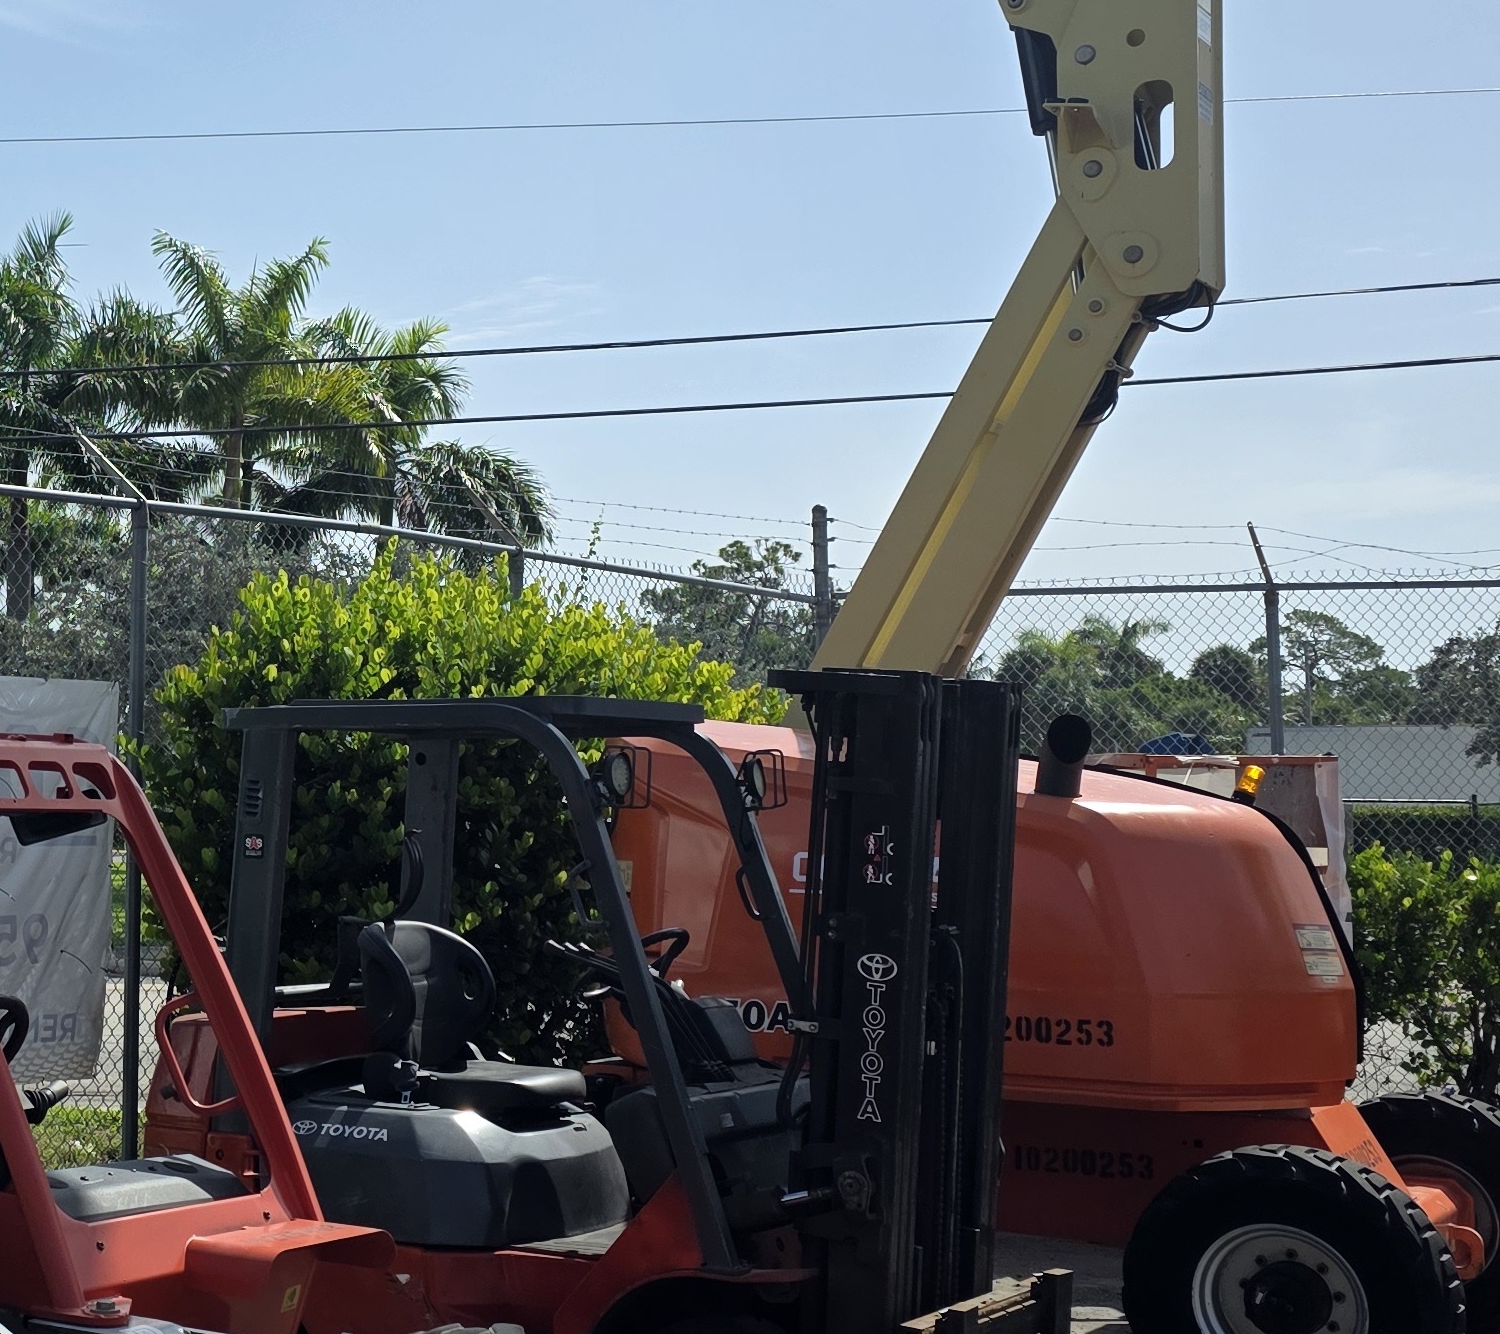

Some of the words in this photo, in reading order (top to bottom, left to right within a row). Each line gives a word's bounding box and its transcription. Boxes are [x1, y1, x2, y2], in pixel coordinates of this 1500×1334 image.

[856, 982, 888, 1123] TOYOTA
[320, 1122, 388, 1142] TOYOTA
[1013, 1144, 1154, 1180] 10200253
